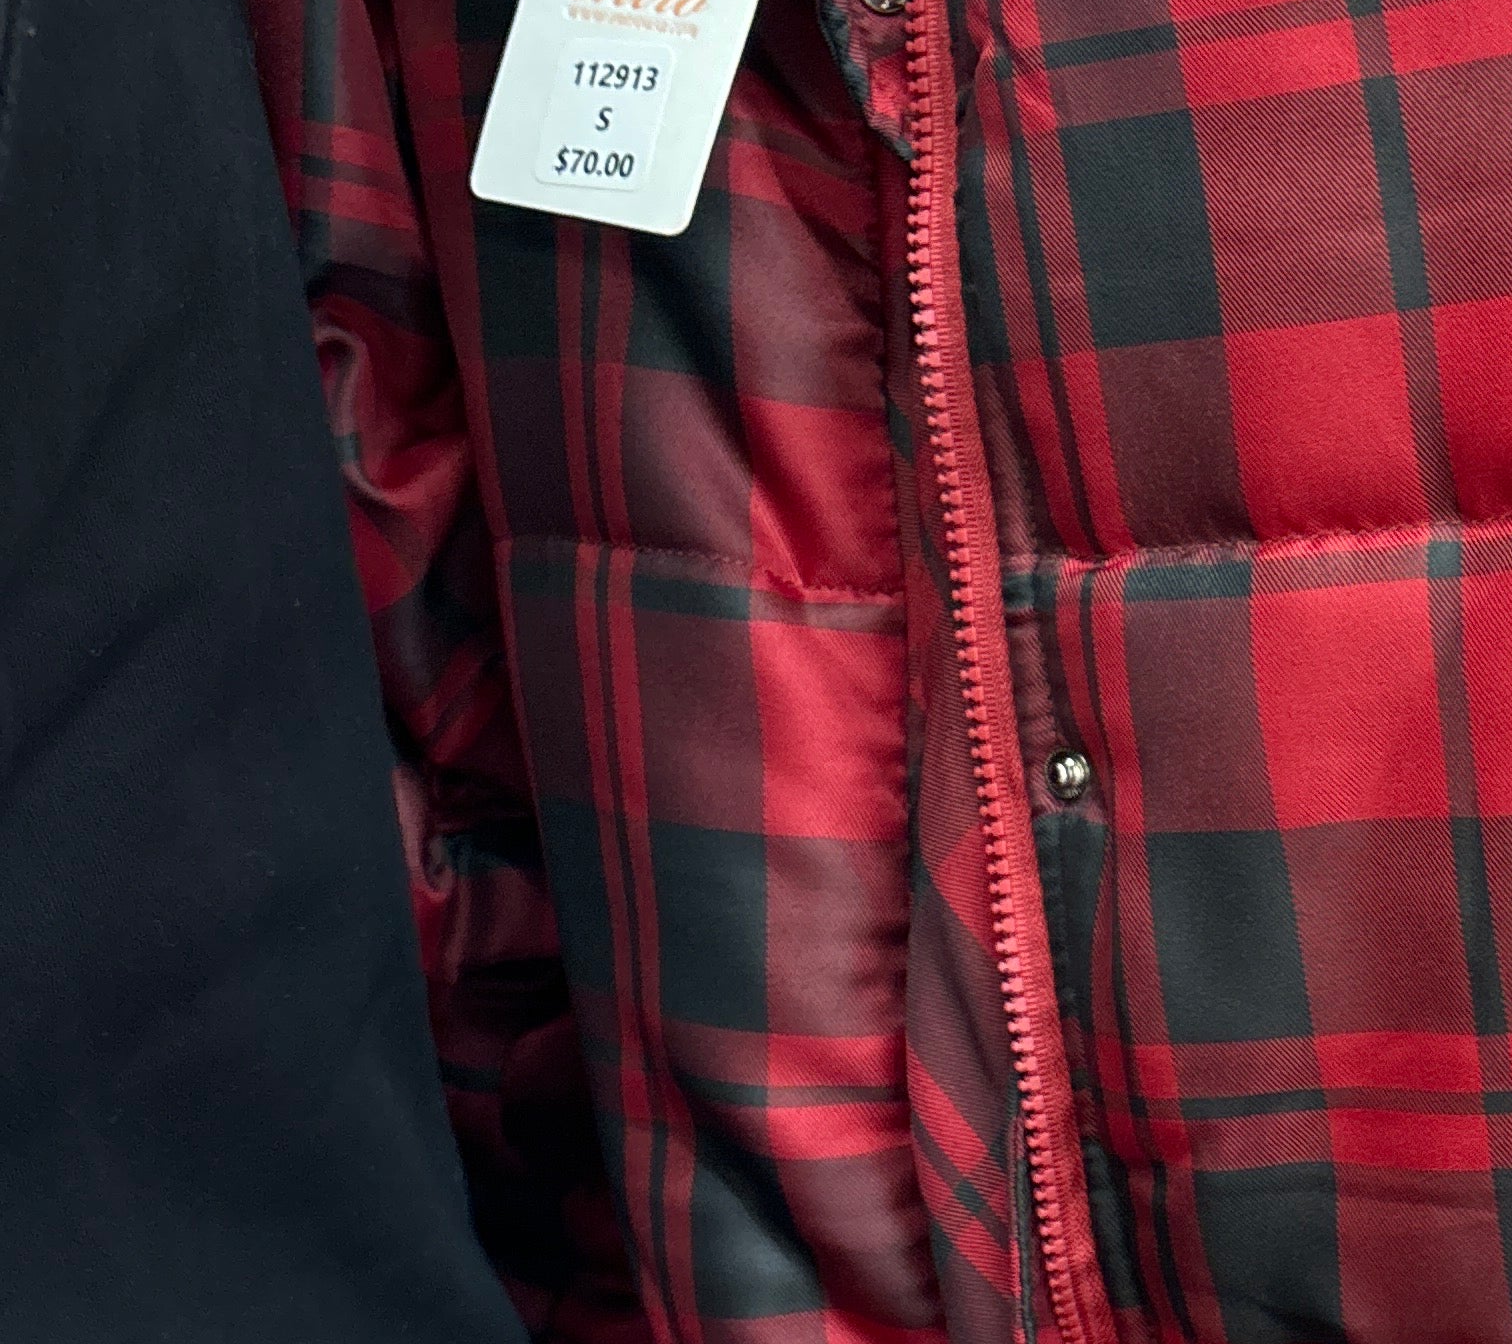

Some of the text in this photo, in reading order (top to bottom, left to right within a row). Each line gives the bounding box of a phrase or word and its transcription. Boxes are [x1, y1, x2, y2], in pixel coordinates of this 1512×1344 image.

[573, 60, 659, 92] 112913
[595, 106, 614, 132] S
[554, 145, 635, 179] $70.00
